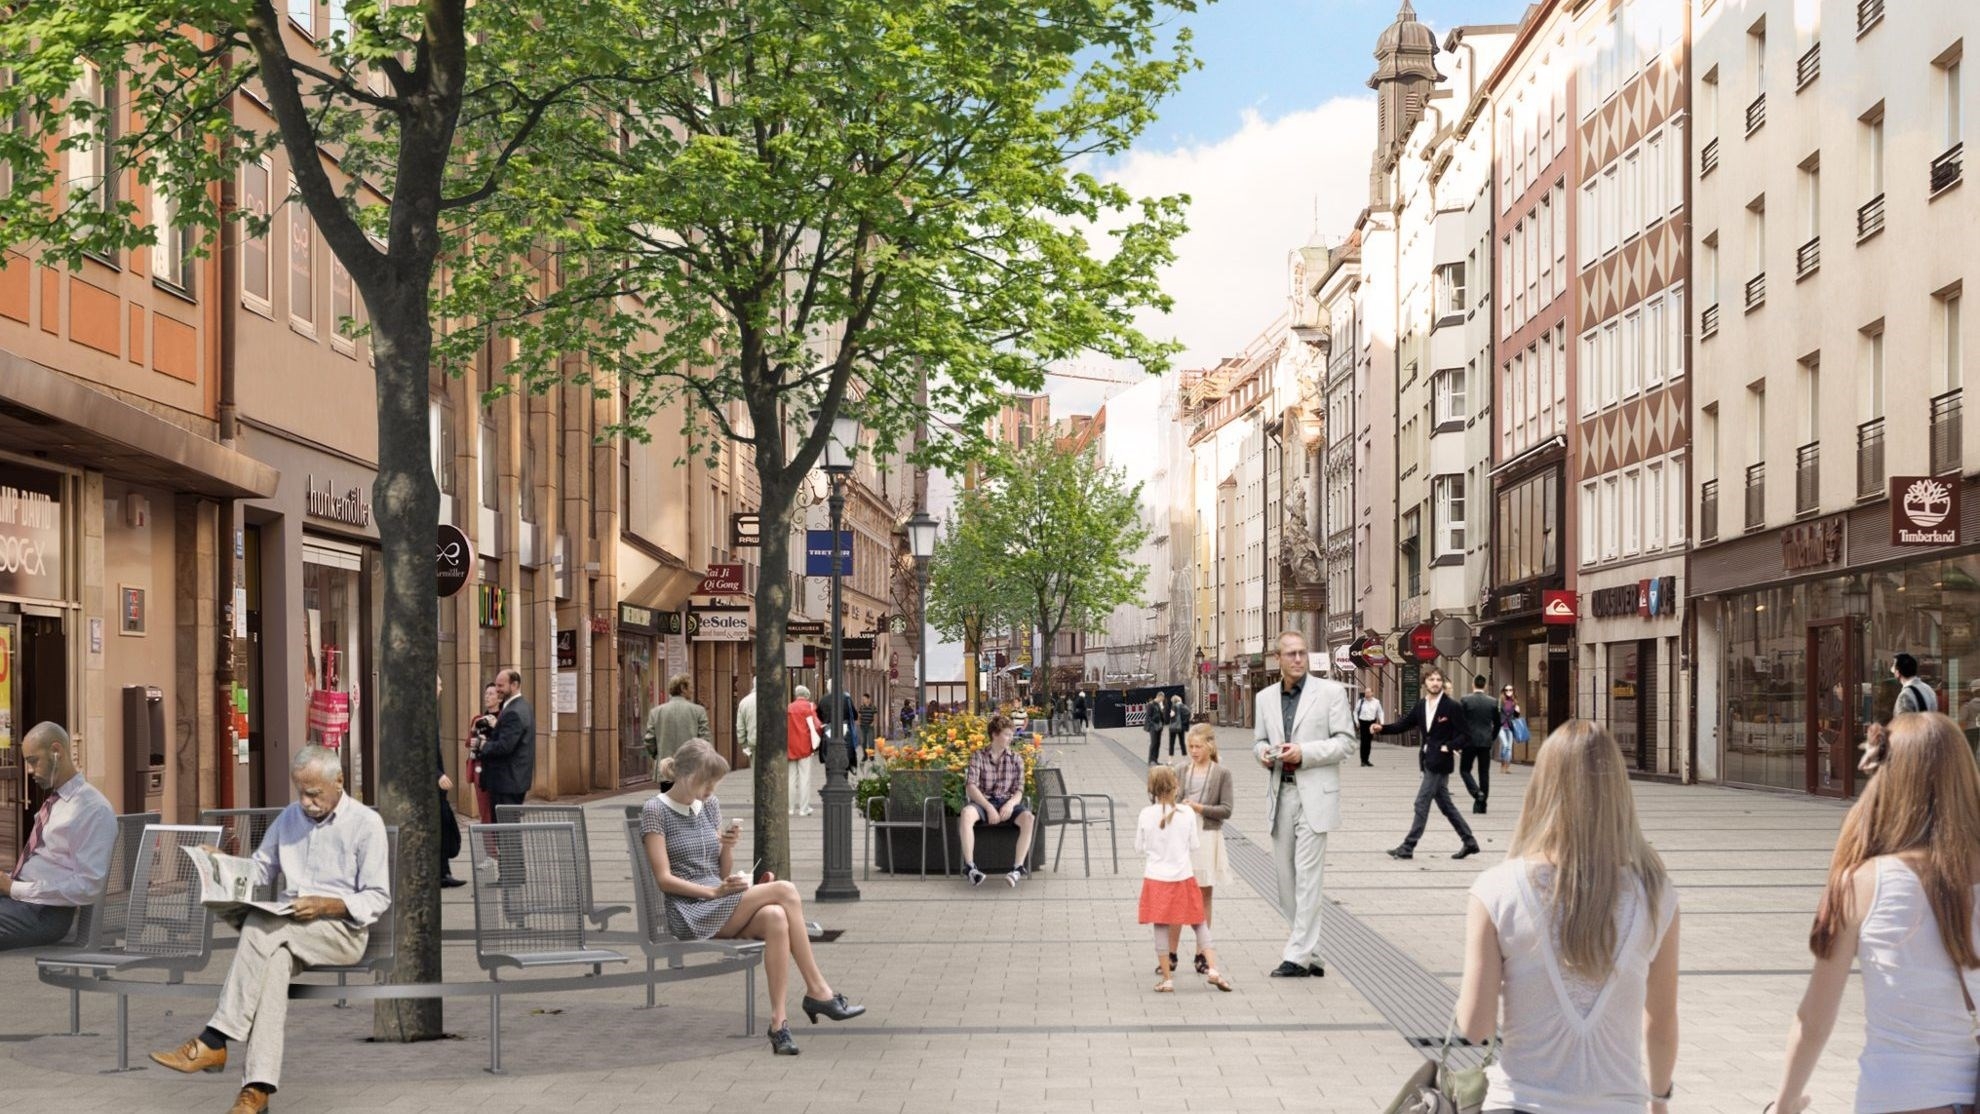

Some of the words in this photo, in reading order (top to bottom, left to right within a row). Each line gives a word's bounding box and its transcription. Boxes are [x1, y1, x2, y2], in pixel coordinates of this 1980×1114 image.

[308, 474, 372, 526] hunkemöller
[1898, 529, 1955, 543] Timberland
[720, 568, 730, 578] Ji
[704, 580, 715, 591] Qi
[716, 580, 739, 590] Gong
